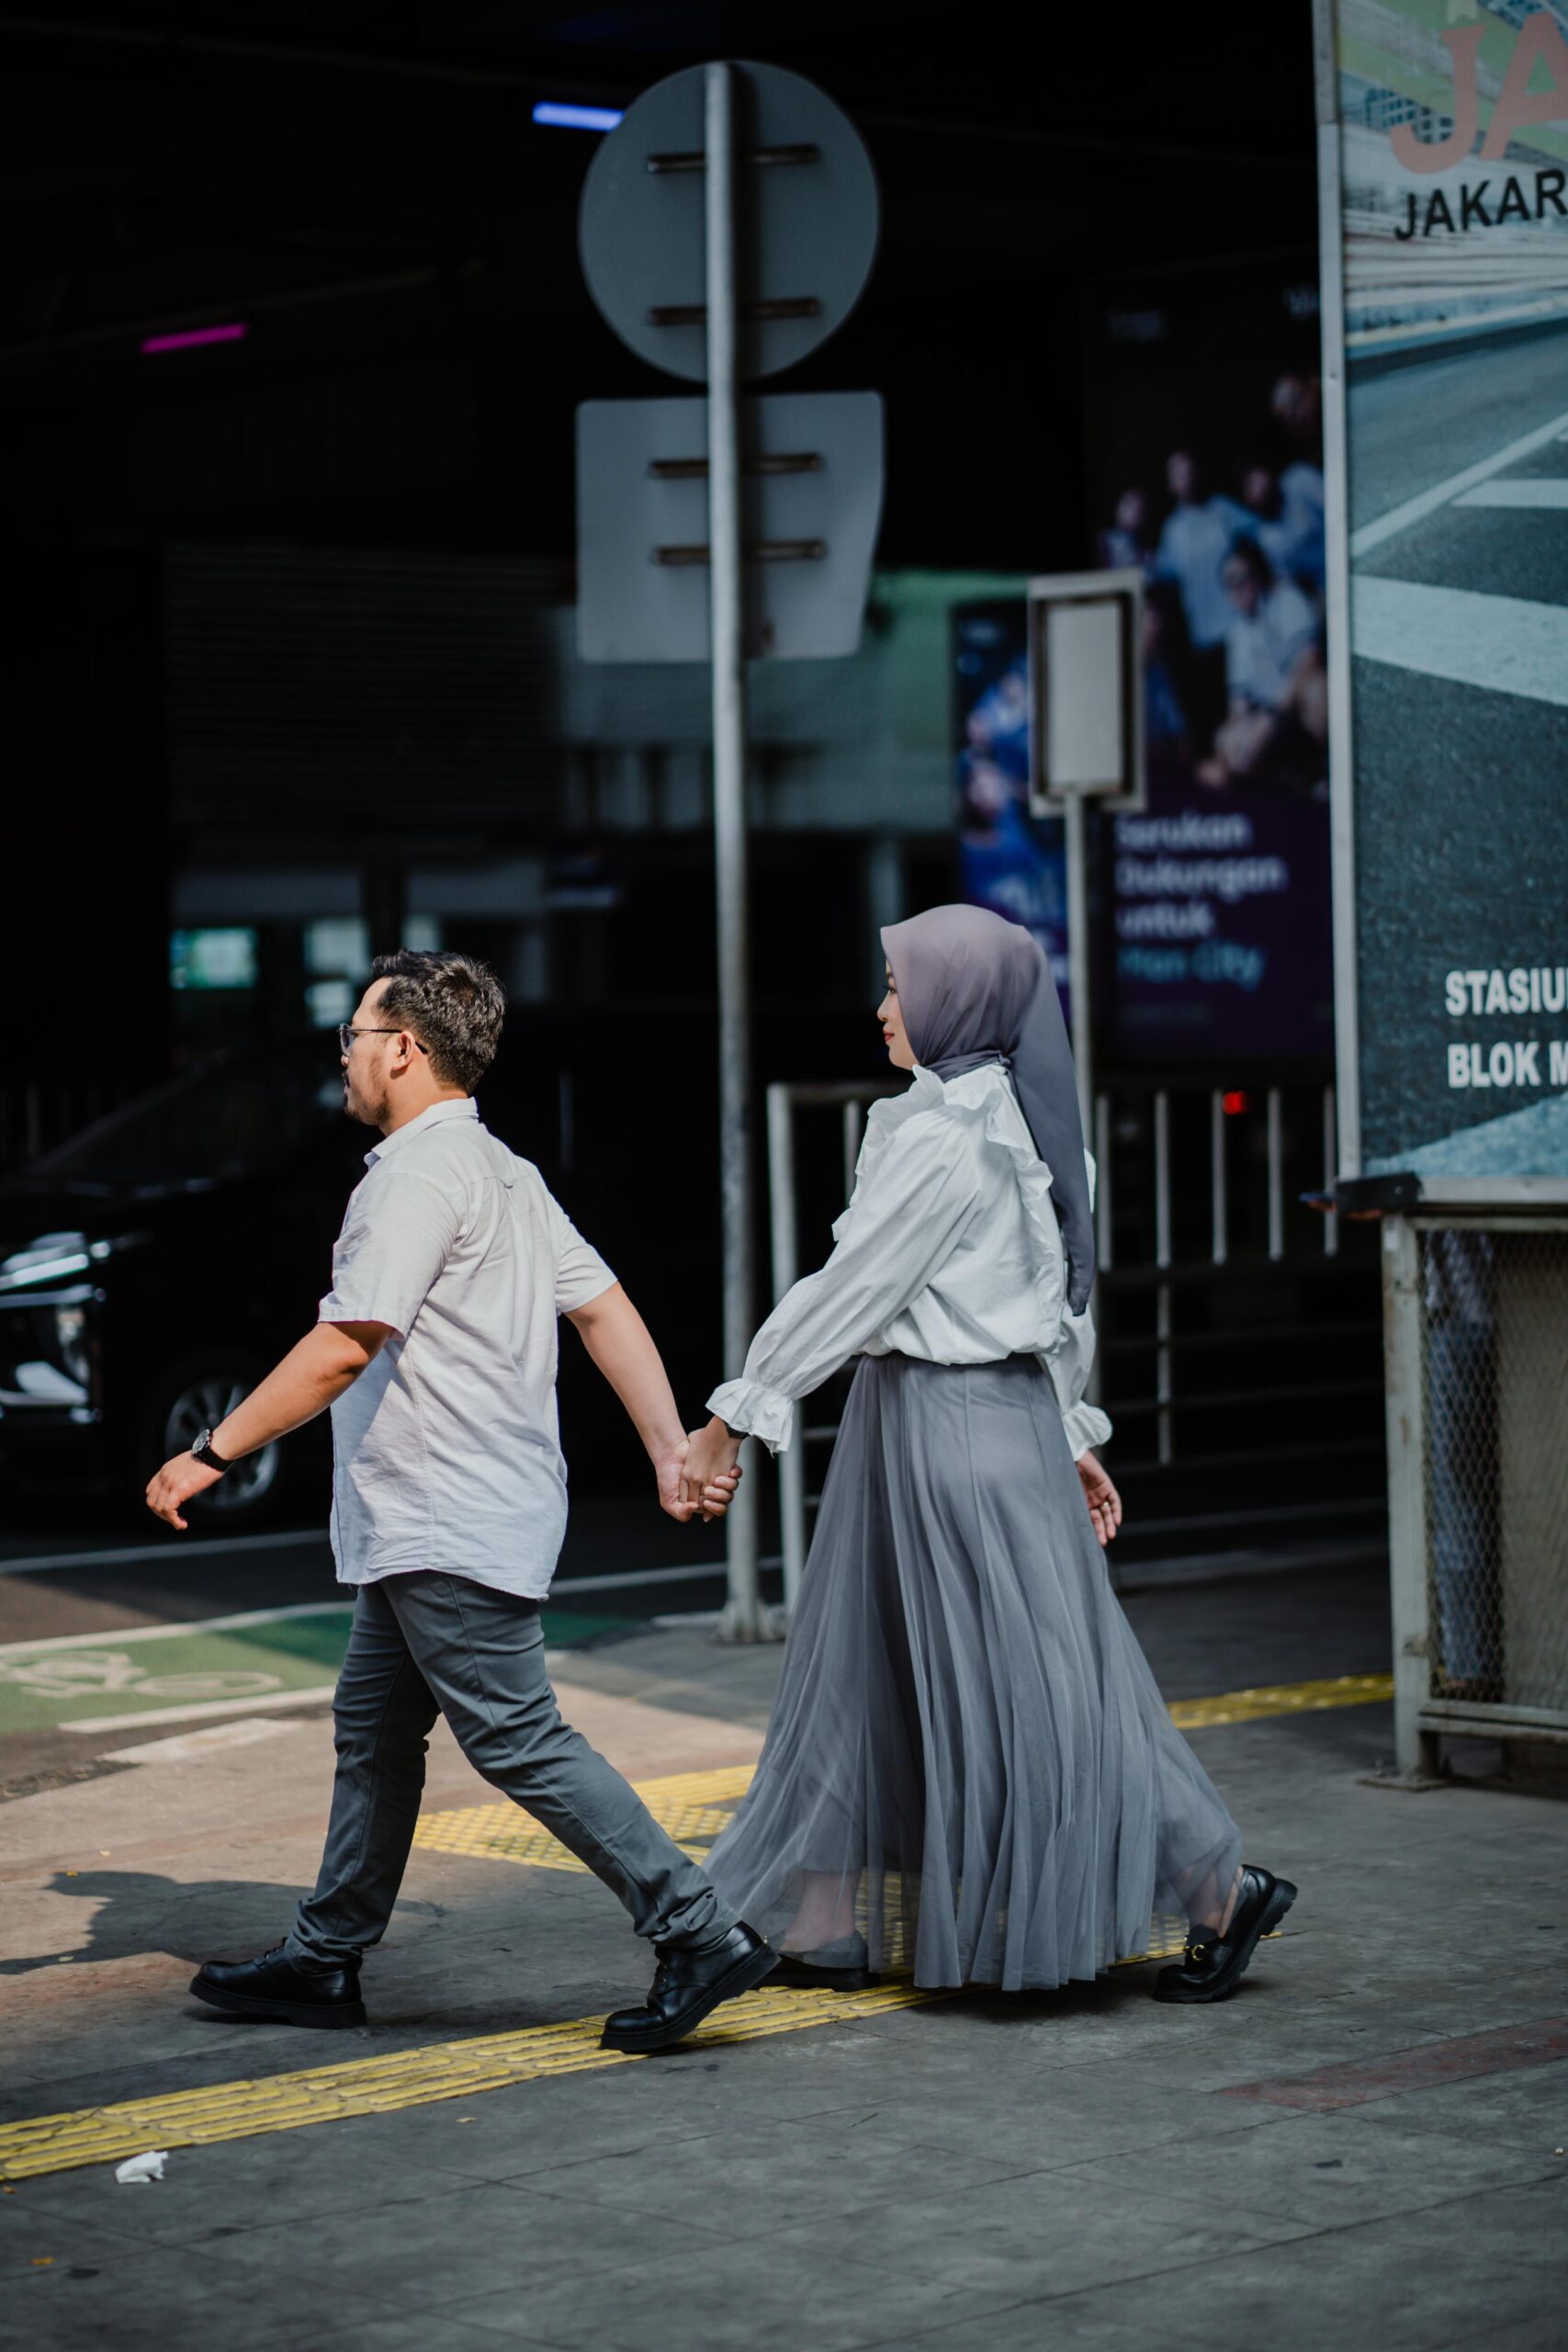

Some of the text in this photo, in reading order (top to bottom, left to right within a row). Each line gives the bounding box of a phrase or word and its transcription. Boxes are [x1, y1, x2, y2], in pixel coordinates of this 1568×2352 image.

[1115, 899, 1215, 939] untuk
[1445, 967, 1568, 1016] STASIU
[1447, 1041, 1541, 1089] BLOK
